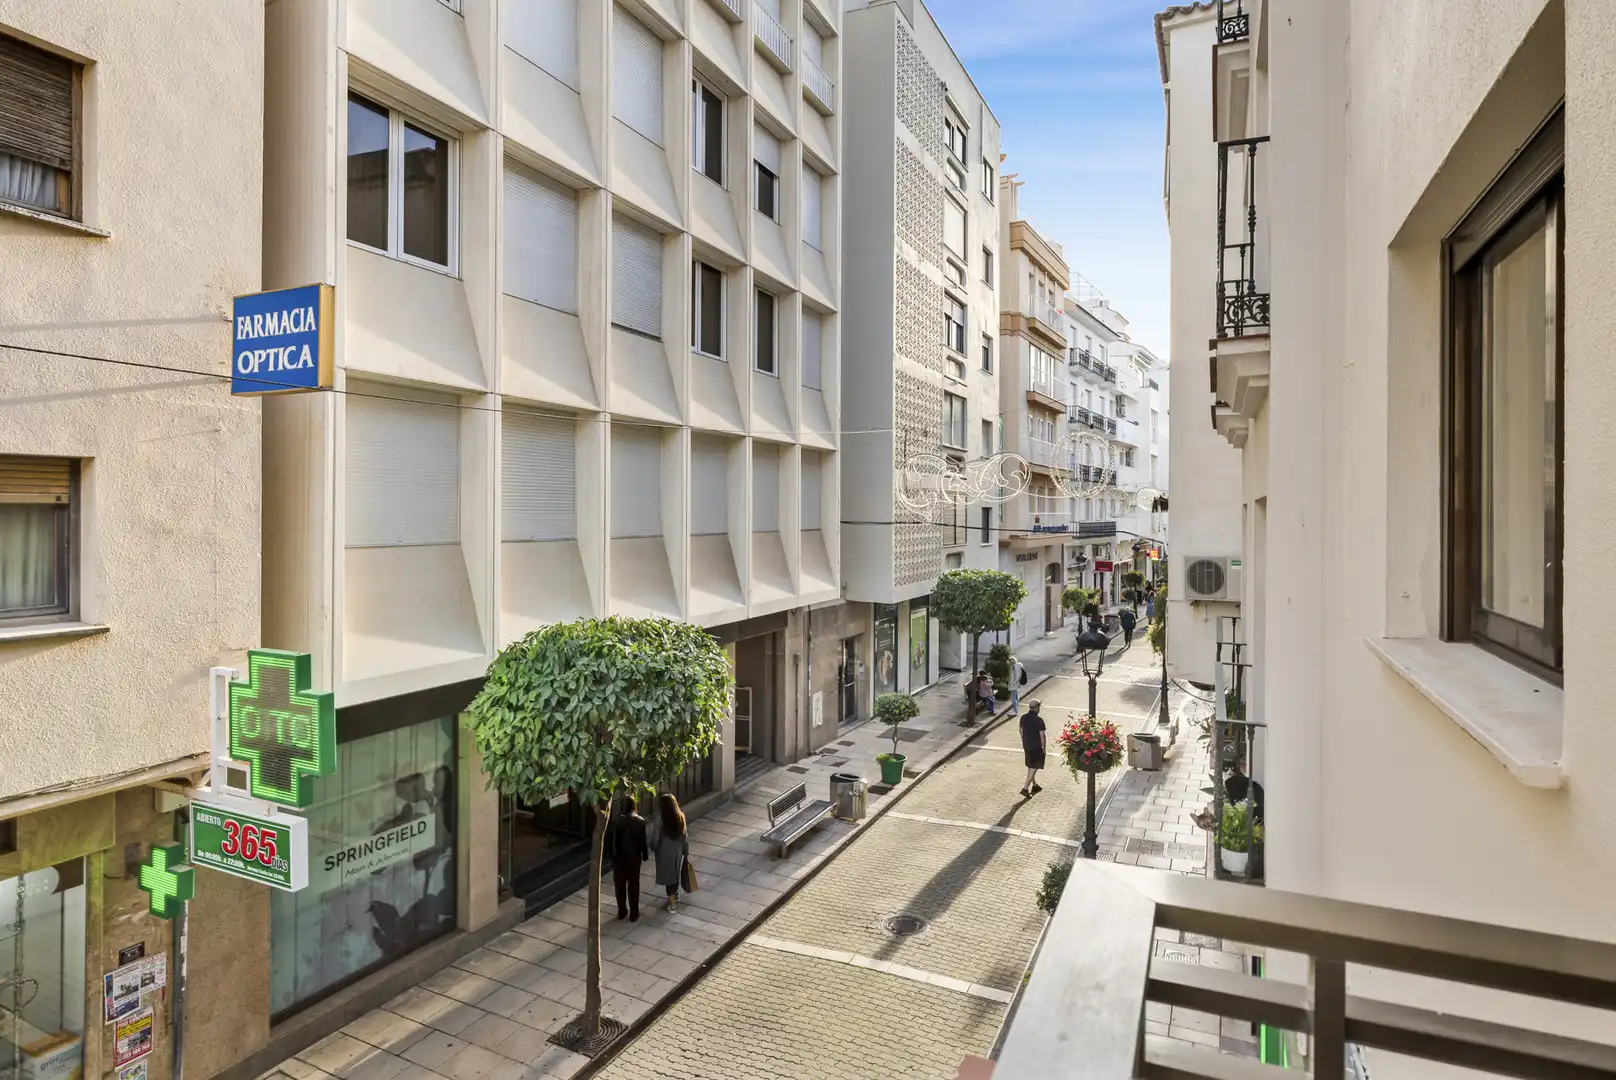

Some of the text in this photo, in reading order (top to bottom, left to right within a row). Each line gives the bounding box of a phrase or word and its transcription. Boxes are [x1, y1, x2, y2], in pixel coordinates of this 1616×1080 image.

[237, 306, 317, 340] FARMACIA
[237, 344, 315, 374] OPTICA
[196, 812, 221, 827] ABIERTO
[221, 819, 277, 866] 365
[271, 854, 289, 873] DÍAS
[324, 820, 427, 872] SPRINGFIELD
